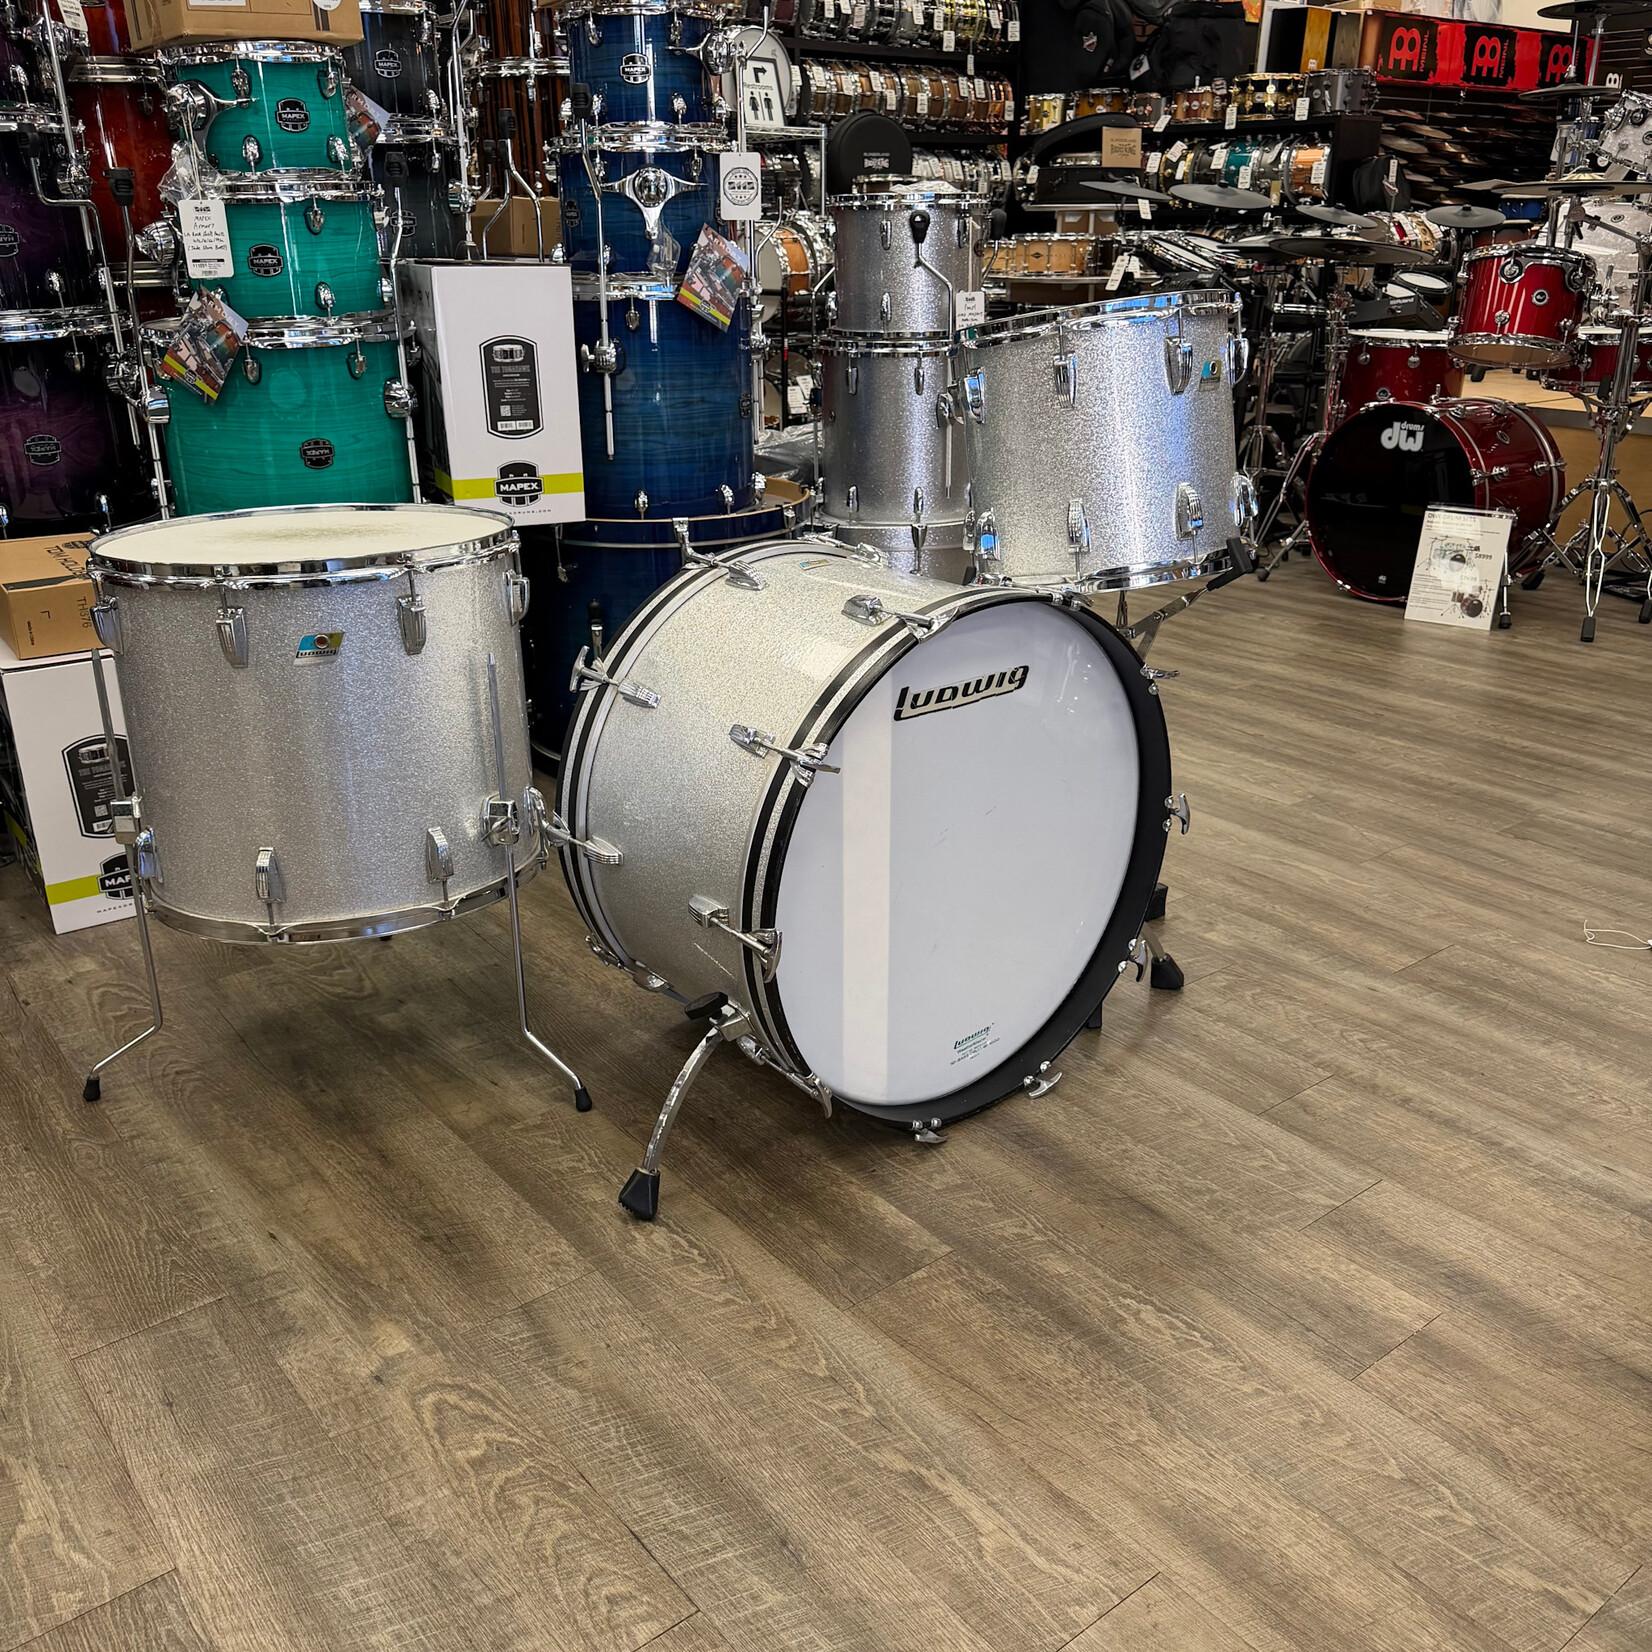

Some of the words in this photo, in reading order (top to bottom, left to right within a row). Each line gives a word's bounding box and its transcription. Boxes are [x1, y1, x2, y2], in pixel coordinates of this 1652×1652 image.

[1419, 31, 1429, 72] MEINL
[1498, 40, 1509, 78] MEINL
[743, 82, 774, 91] Restrooms
[281, 112, 306, 120] MAPEX
[1401, 421, 1425, 431] drums
[1380, 421, 1425, 452] dw
[500, 482, 539, 492] MAPEX
[104, 875, 131, 888] MAP
